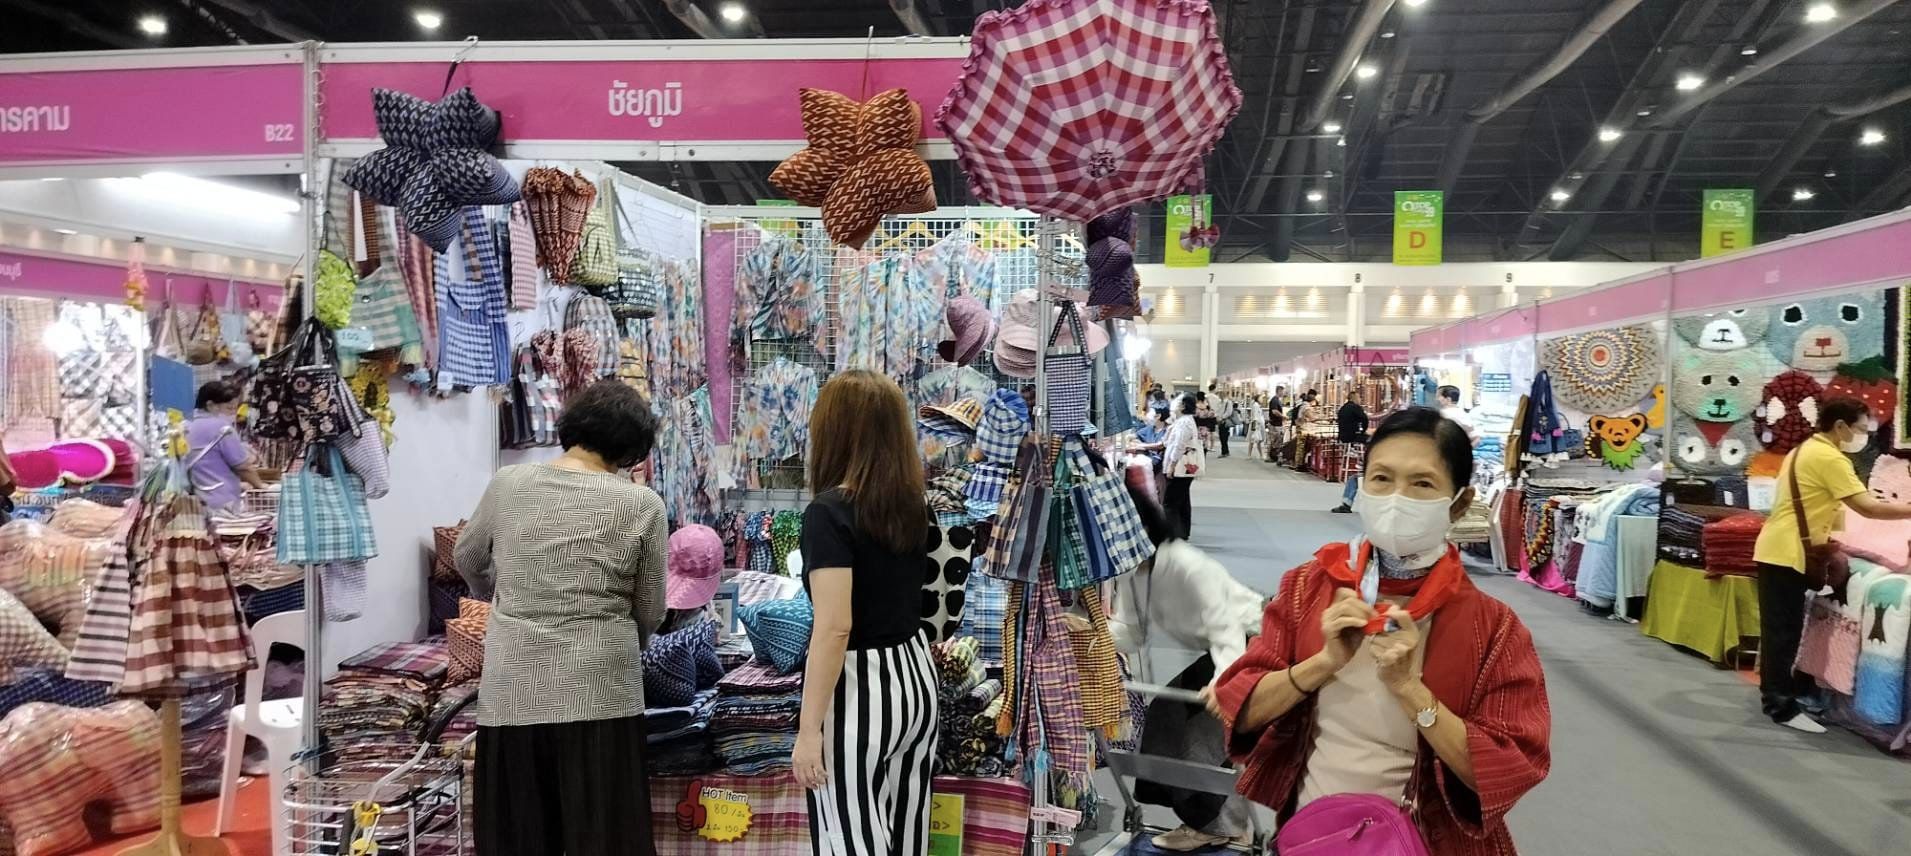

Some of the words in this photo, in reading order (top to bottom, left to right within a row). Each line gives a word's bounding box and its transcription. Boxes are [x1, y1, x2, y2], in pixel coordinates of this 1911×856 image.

[608, 80, 682, 128] ชัยภูมิ
[264, 124, 295, 141] B22
[1409, 230, 1426, 249] D
[1720, 231, 1736, 249] E
[1208, 272, 1215, 284] 7
[1354, 272, 1361, 284] 8
[1505, 272, 1513, 284] 9
[702, 787, 724, 799] HOT
[725, 790, 748, 803] Item
[713, 802, 729, 815] 80
